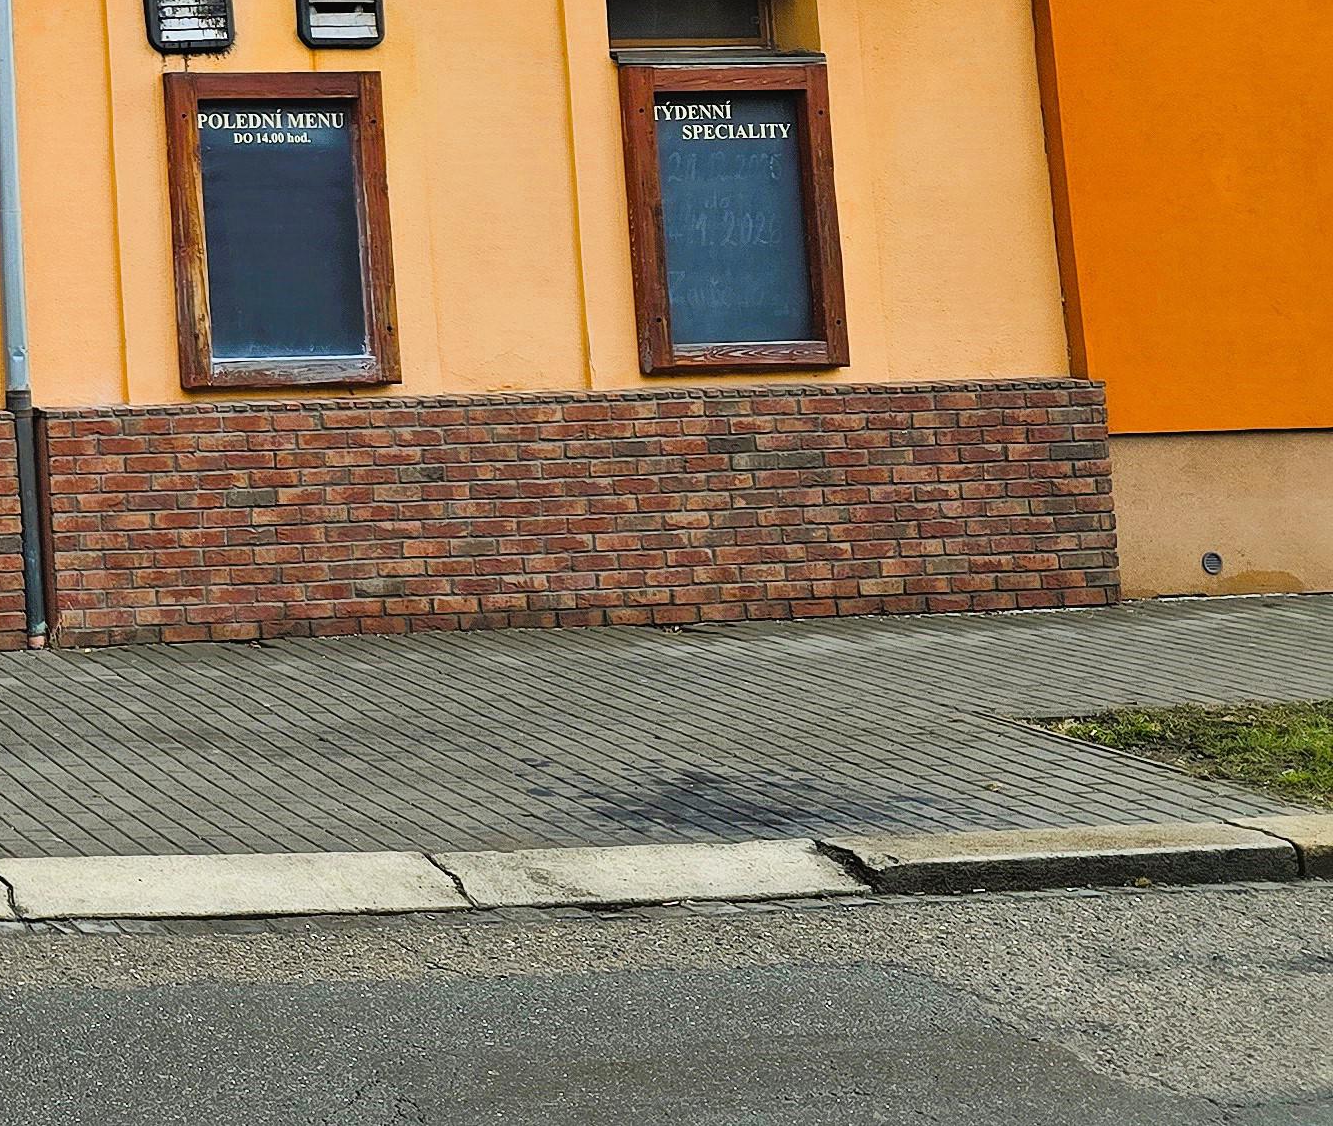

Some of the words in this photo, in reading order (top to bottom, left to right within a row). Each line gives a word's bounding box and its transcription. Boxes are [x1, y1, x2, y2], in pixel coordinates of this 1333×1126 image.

[197, 109, 282, 130] POLEDNÍ
[287, 112, 345, 130] MENU
[654, 100, 732, 121] TÝDENNÍ
[233, 132, 253, 144] DO
[256, 132, 285, 144] 14.00
[287, 131, 312, 144] hod.
[682, 123, 792, 140] SPECIALITY
